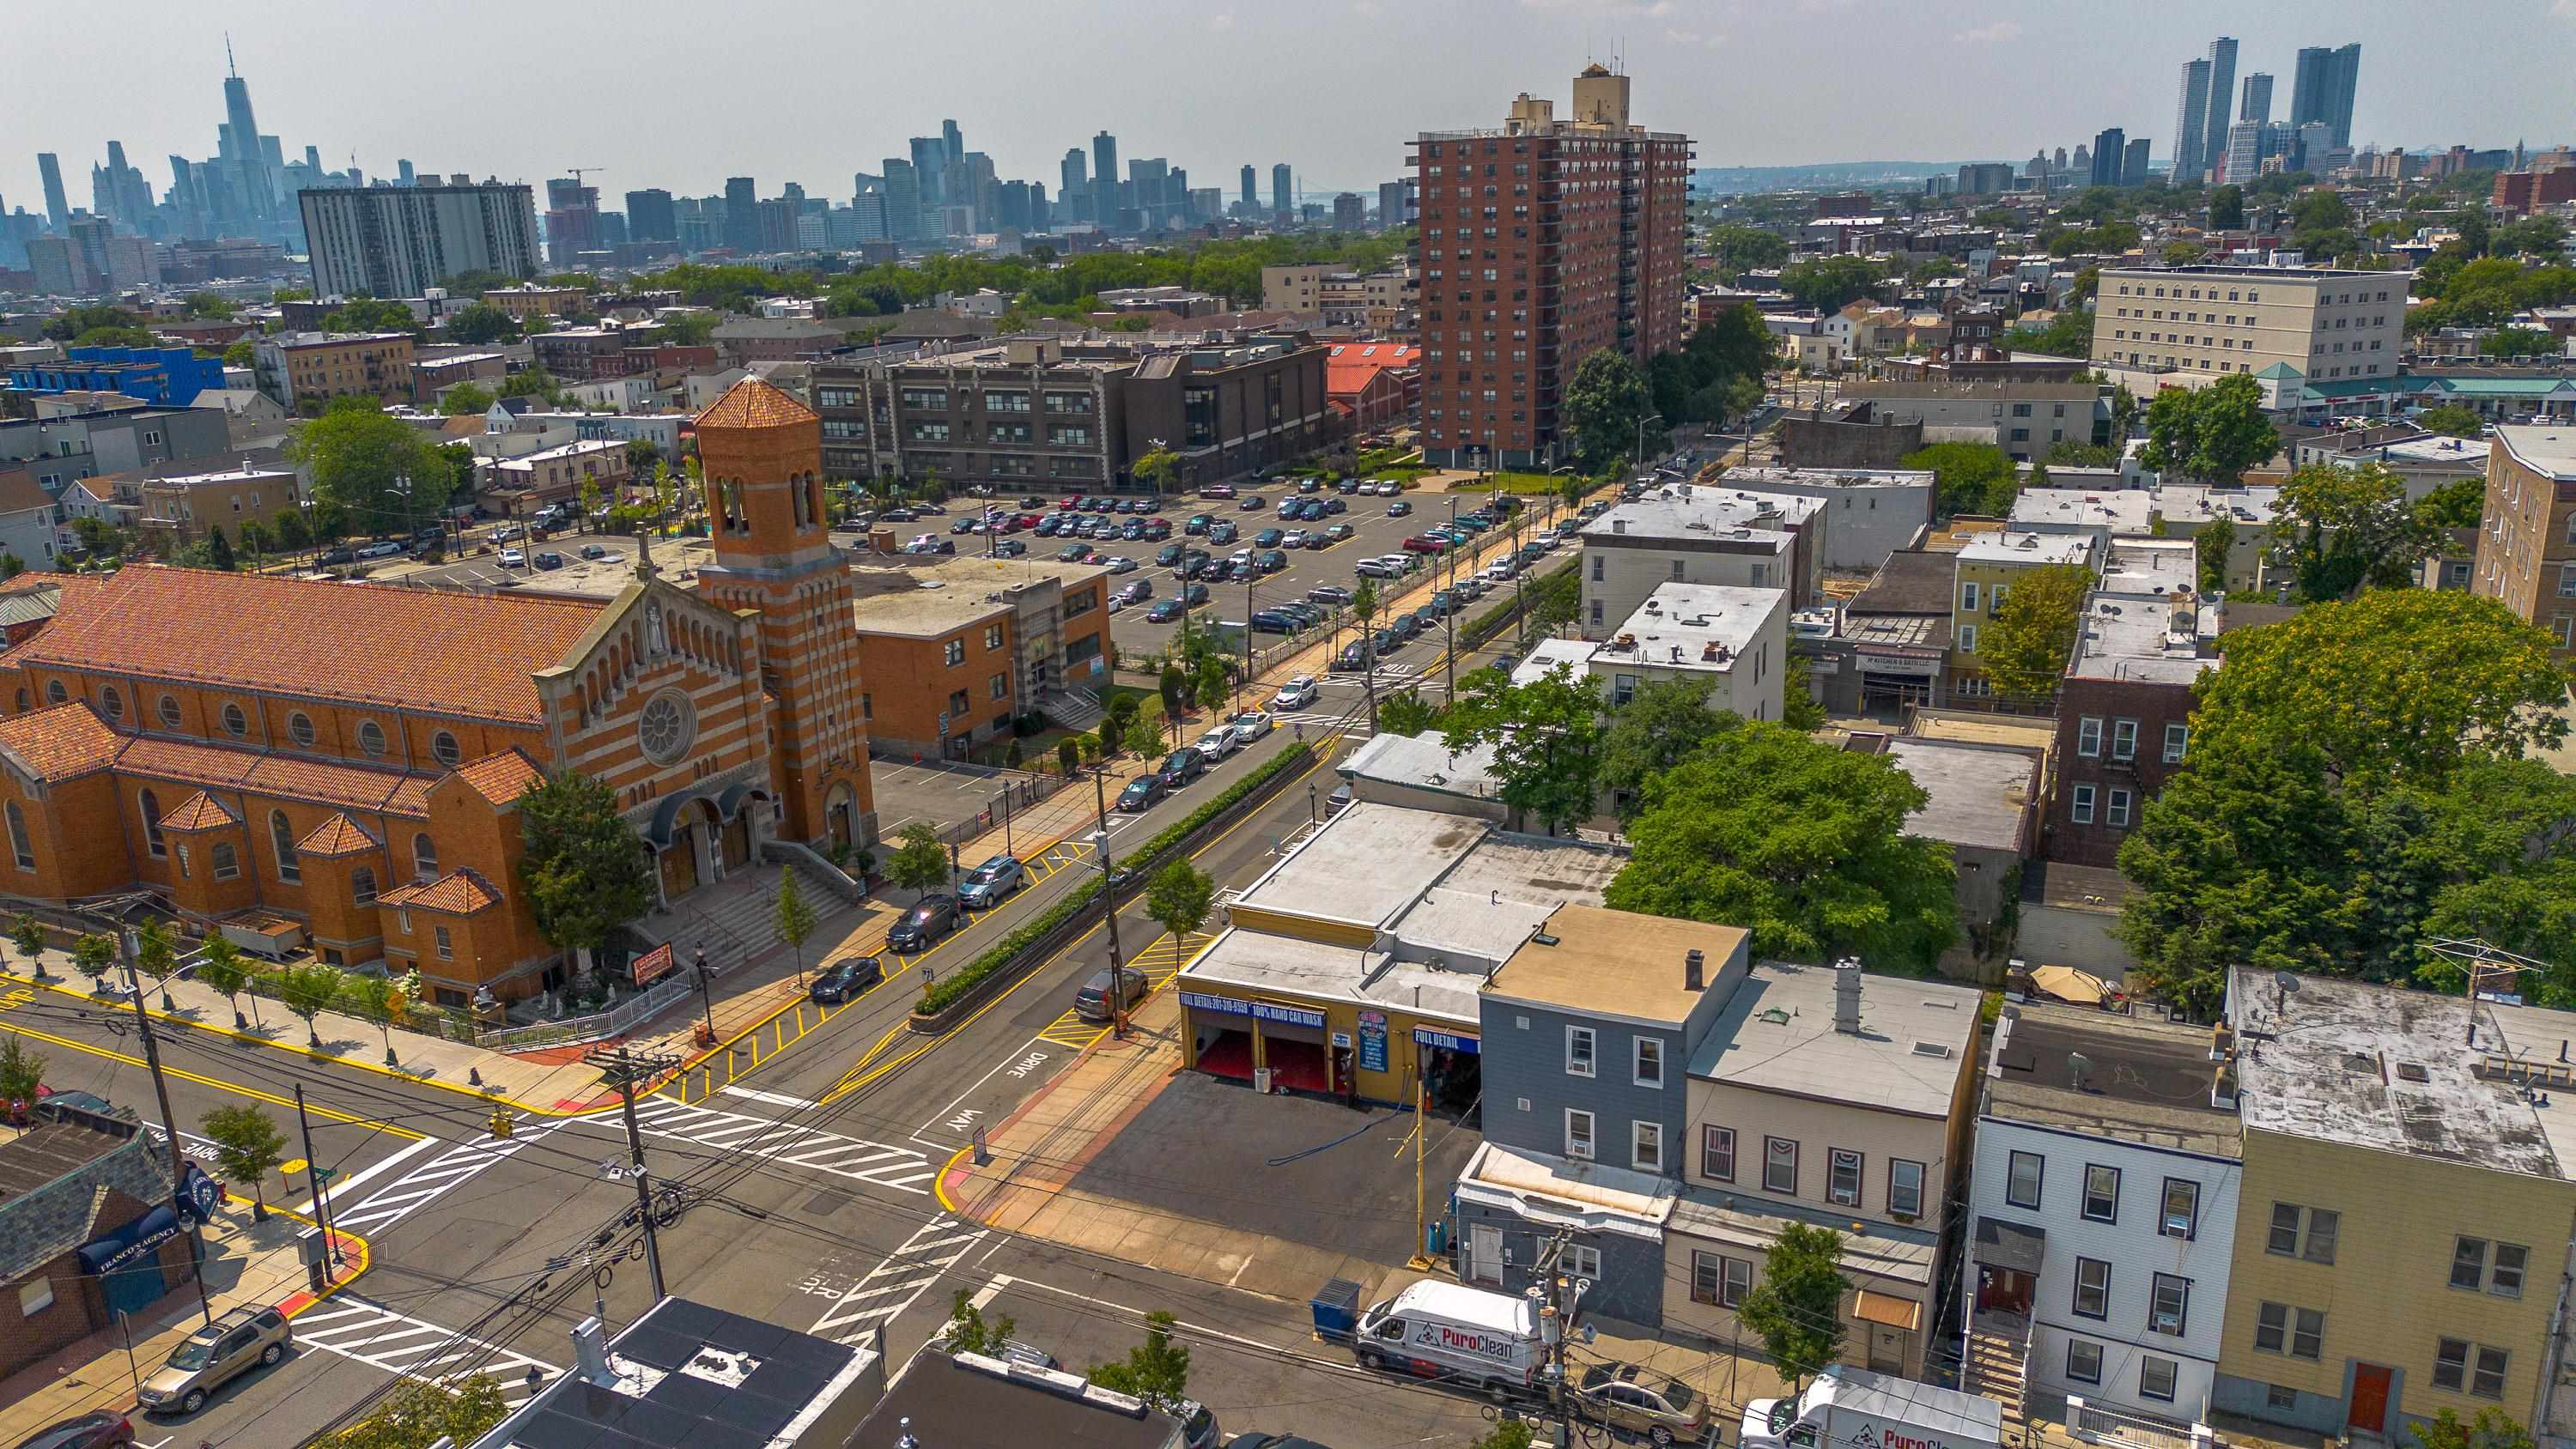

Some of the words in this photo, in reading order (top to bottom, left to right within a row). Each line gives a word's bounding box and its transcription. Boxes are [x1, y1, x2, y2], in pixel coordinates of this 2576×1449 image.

[1180, 993, 1194, 1004] FULL
[1253, 1005, 1271, 1018] 100%
[1271, 1007, 1288, 1021] HAND
[1289, 1009, 1302, 1023] CAR
[1303, 1012, 1322, 1027] WASH
[1415, 1030, 1432, 1044] FULL
[1433, 1034, 1459, 1049] DETAIL
[1006, 1052, 1048, 1079] DRIVE
[945, 1109, 983, 1131] WAY
[100, 1241, 143, 1271] FRANCO'S
[142, 1228, 175, 1247] AGENCY
[1443, 1327, 1512, 1358] PuroClean
